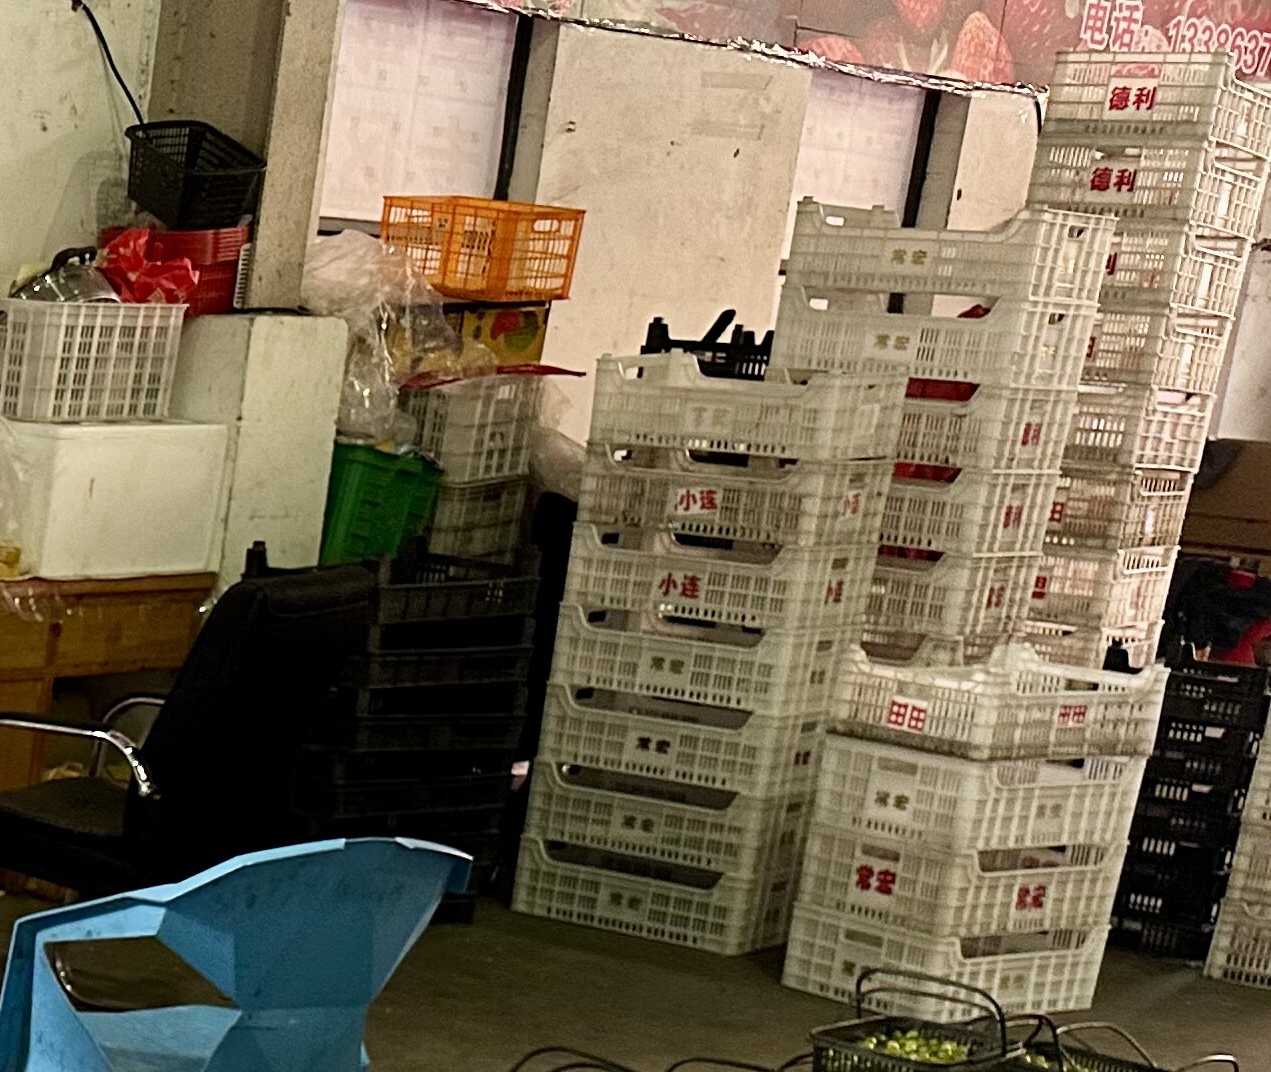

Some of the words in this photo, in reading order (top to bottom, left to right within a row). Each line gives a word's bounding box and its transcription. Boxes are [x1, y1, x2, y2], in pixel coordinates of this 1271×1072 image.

[1108, 87, 1157, 111] 德利
[1090, 167, 1138, 192] 德利
[886, 700, 927, 732] 田田
